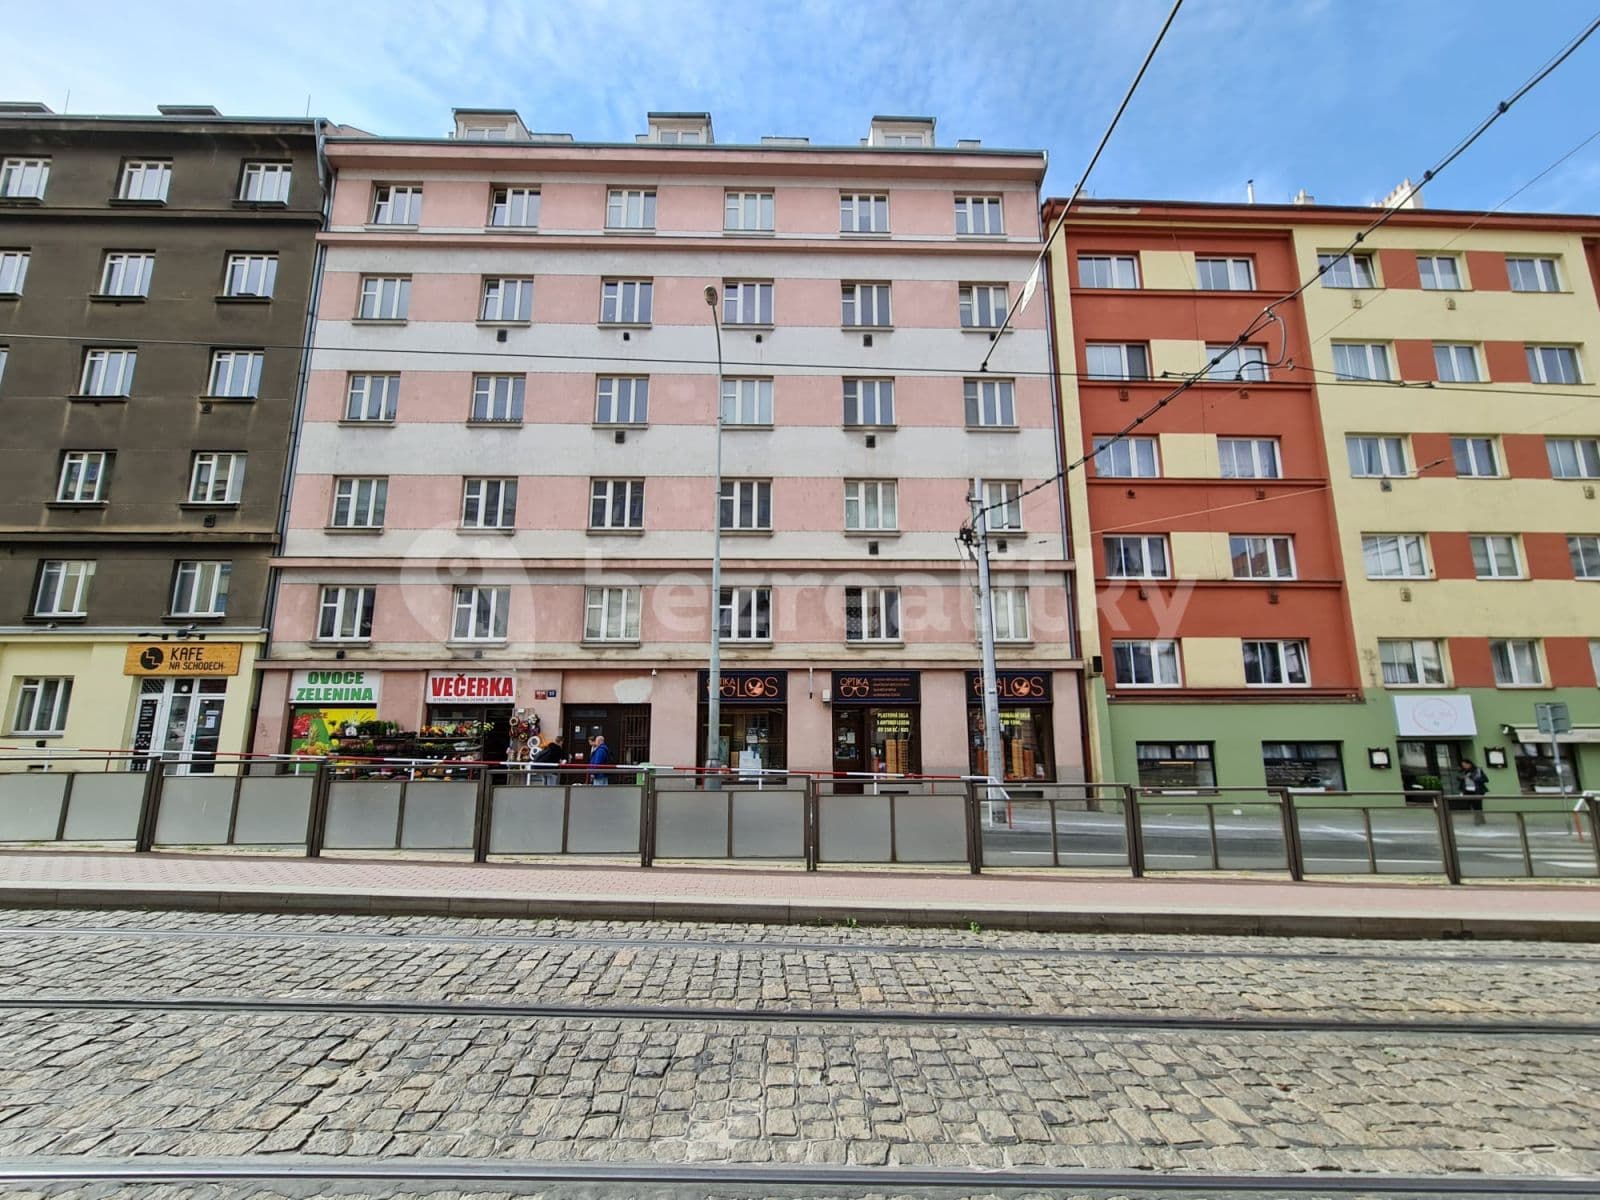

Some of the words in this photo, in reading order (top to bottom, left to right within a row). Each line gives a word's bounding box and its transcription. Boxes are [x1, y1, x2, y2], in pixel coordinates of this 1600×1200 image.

[170, 647, 204, 660] KAFE
[182, 661, 223, 671] SCHODECH
[308, 672, 363, 684] OVOCE
[840, 677, 869, 686] OPTIKA
[432, 673, 513, 696] VEČERKA
[296, 688, 373, 700] ZELENINA
